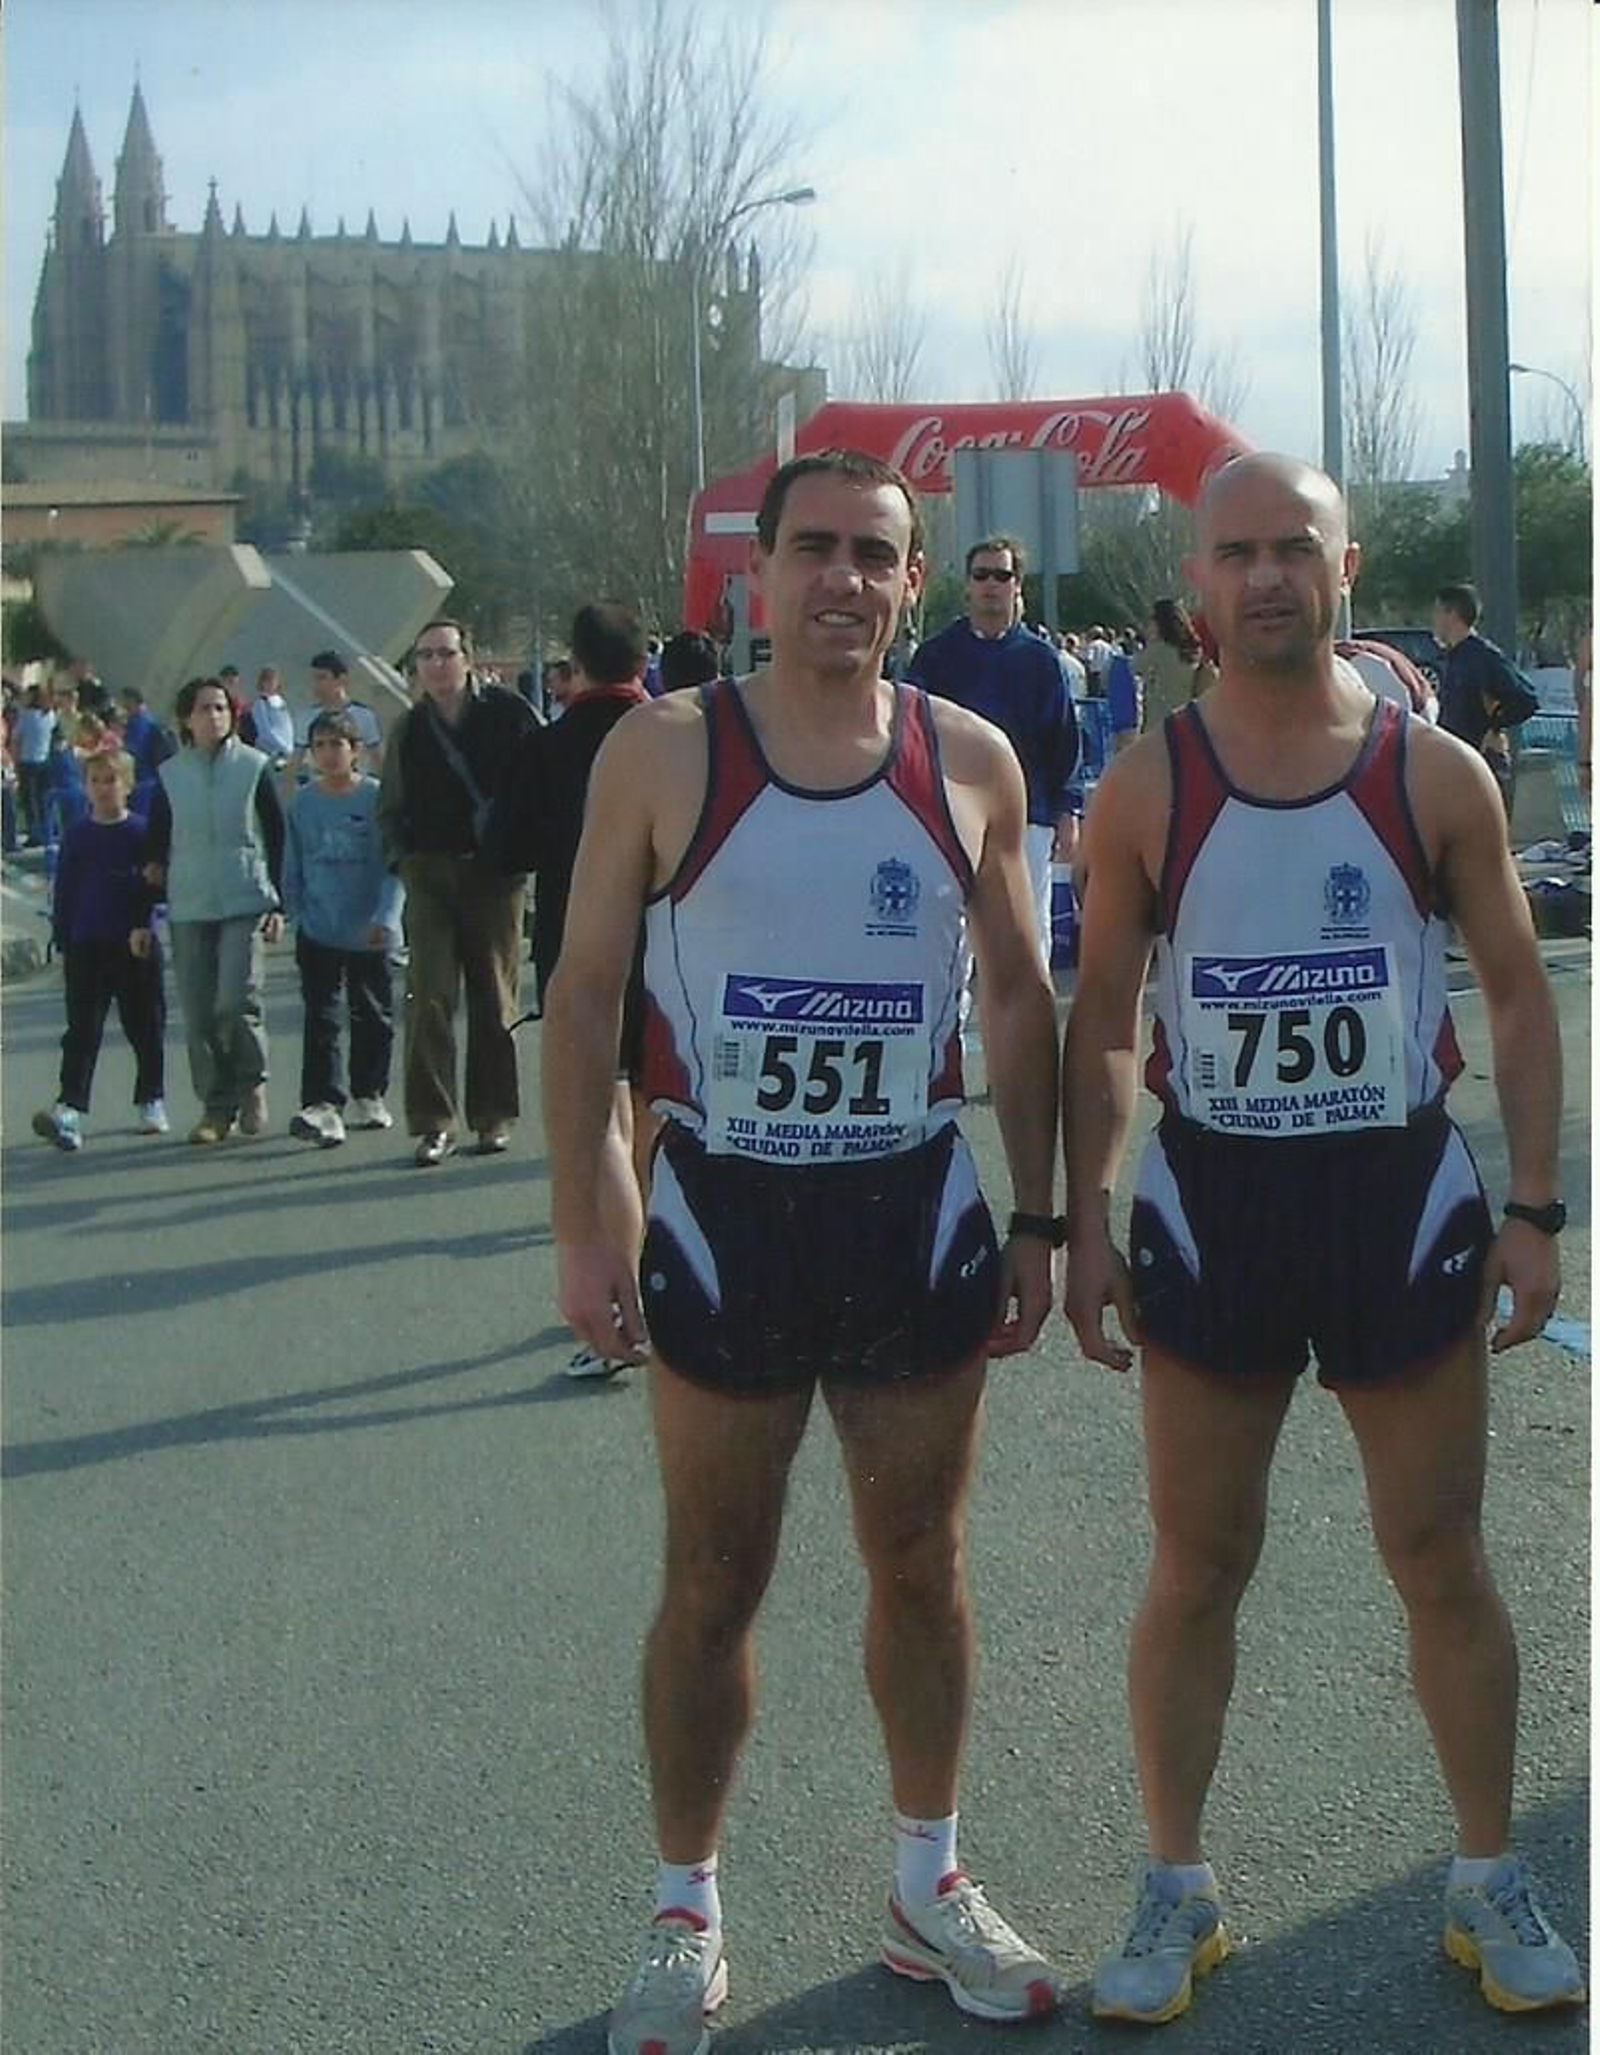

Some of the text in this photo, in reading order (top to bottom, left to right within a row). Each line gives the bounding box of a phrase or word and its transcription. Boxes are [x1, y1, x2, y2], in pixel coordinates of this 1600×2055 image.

[1228, 1006, 1366, 1087] 750
[756, 1035, 890, 1115] 551
[1209, 1085, 1386, 1113] XIII MEDIA MARATÓN
[727, 1117, 757, 1135] XIII
[765, 1122, 820, 1140] MEDIA
[1291, 1112, 1316, 1128] DE
[810, 1141, 832, 1157] DE
